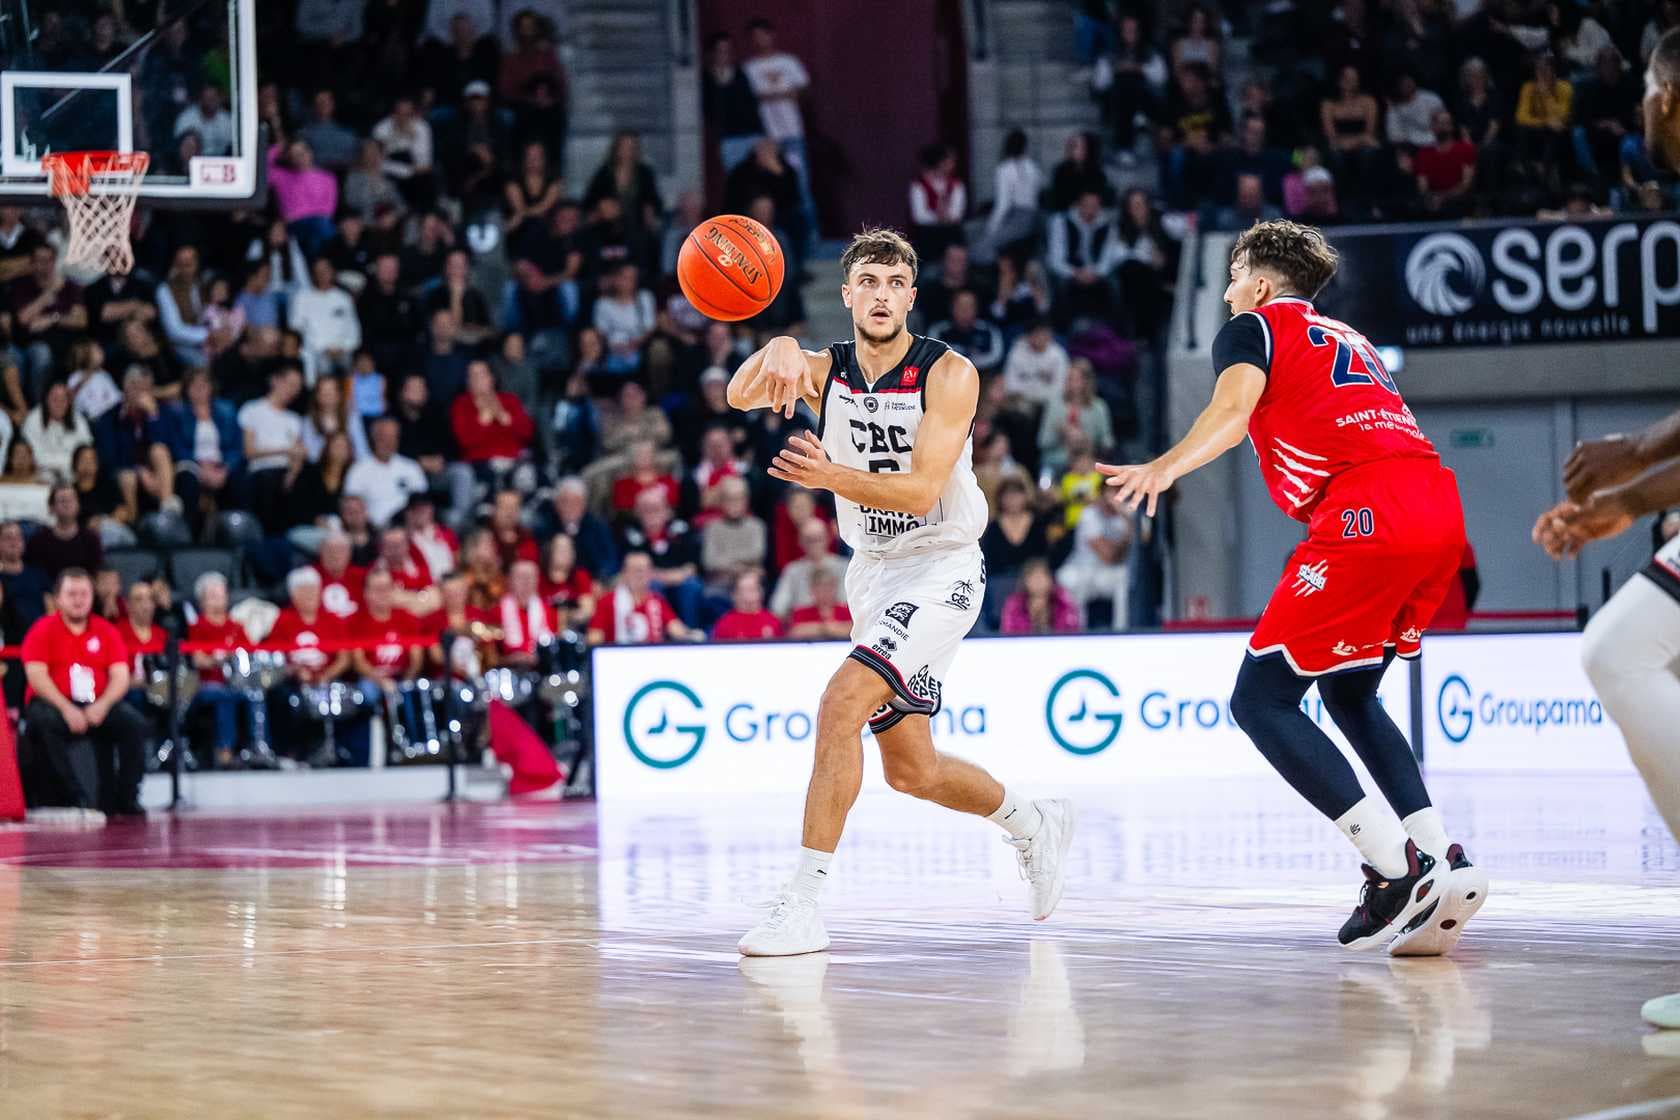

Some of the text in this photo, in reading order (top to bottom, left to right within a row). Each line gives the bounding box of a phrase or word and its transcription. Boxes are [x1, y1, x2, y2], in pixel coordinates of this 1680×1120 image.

[1491, 221, 1680, 334] serp
[1306, 325, 1400, 396] 20
[849, 418, 913, 454] CBC
[868, 515, 920, 536] IMMO
[1341, 507, 1375, 538] 20
[1480, 692, 1602, 732] Groupama
